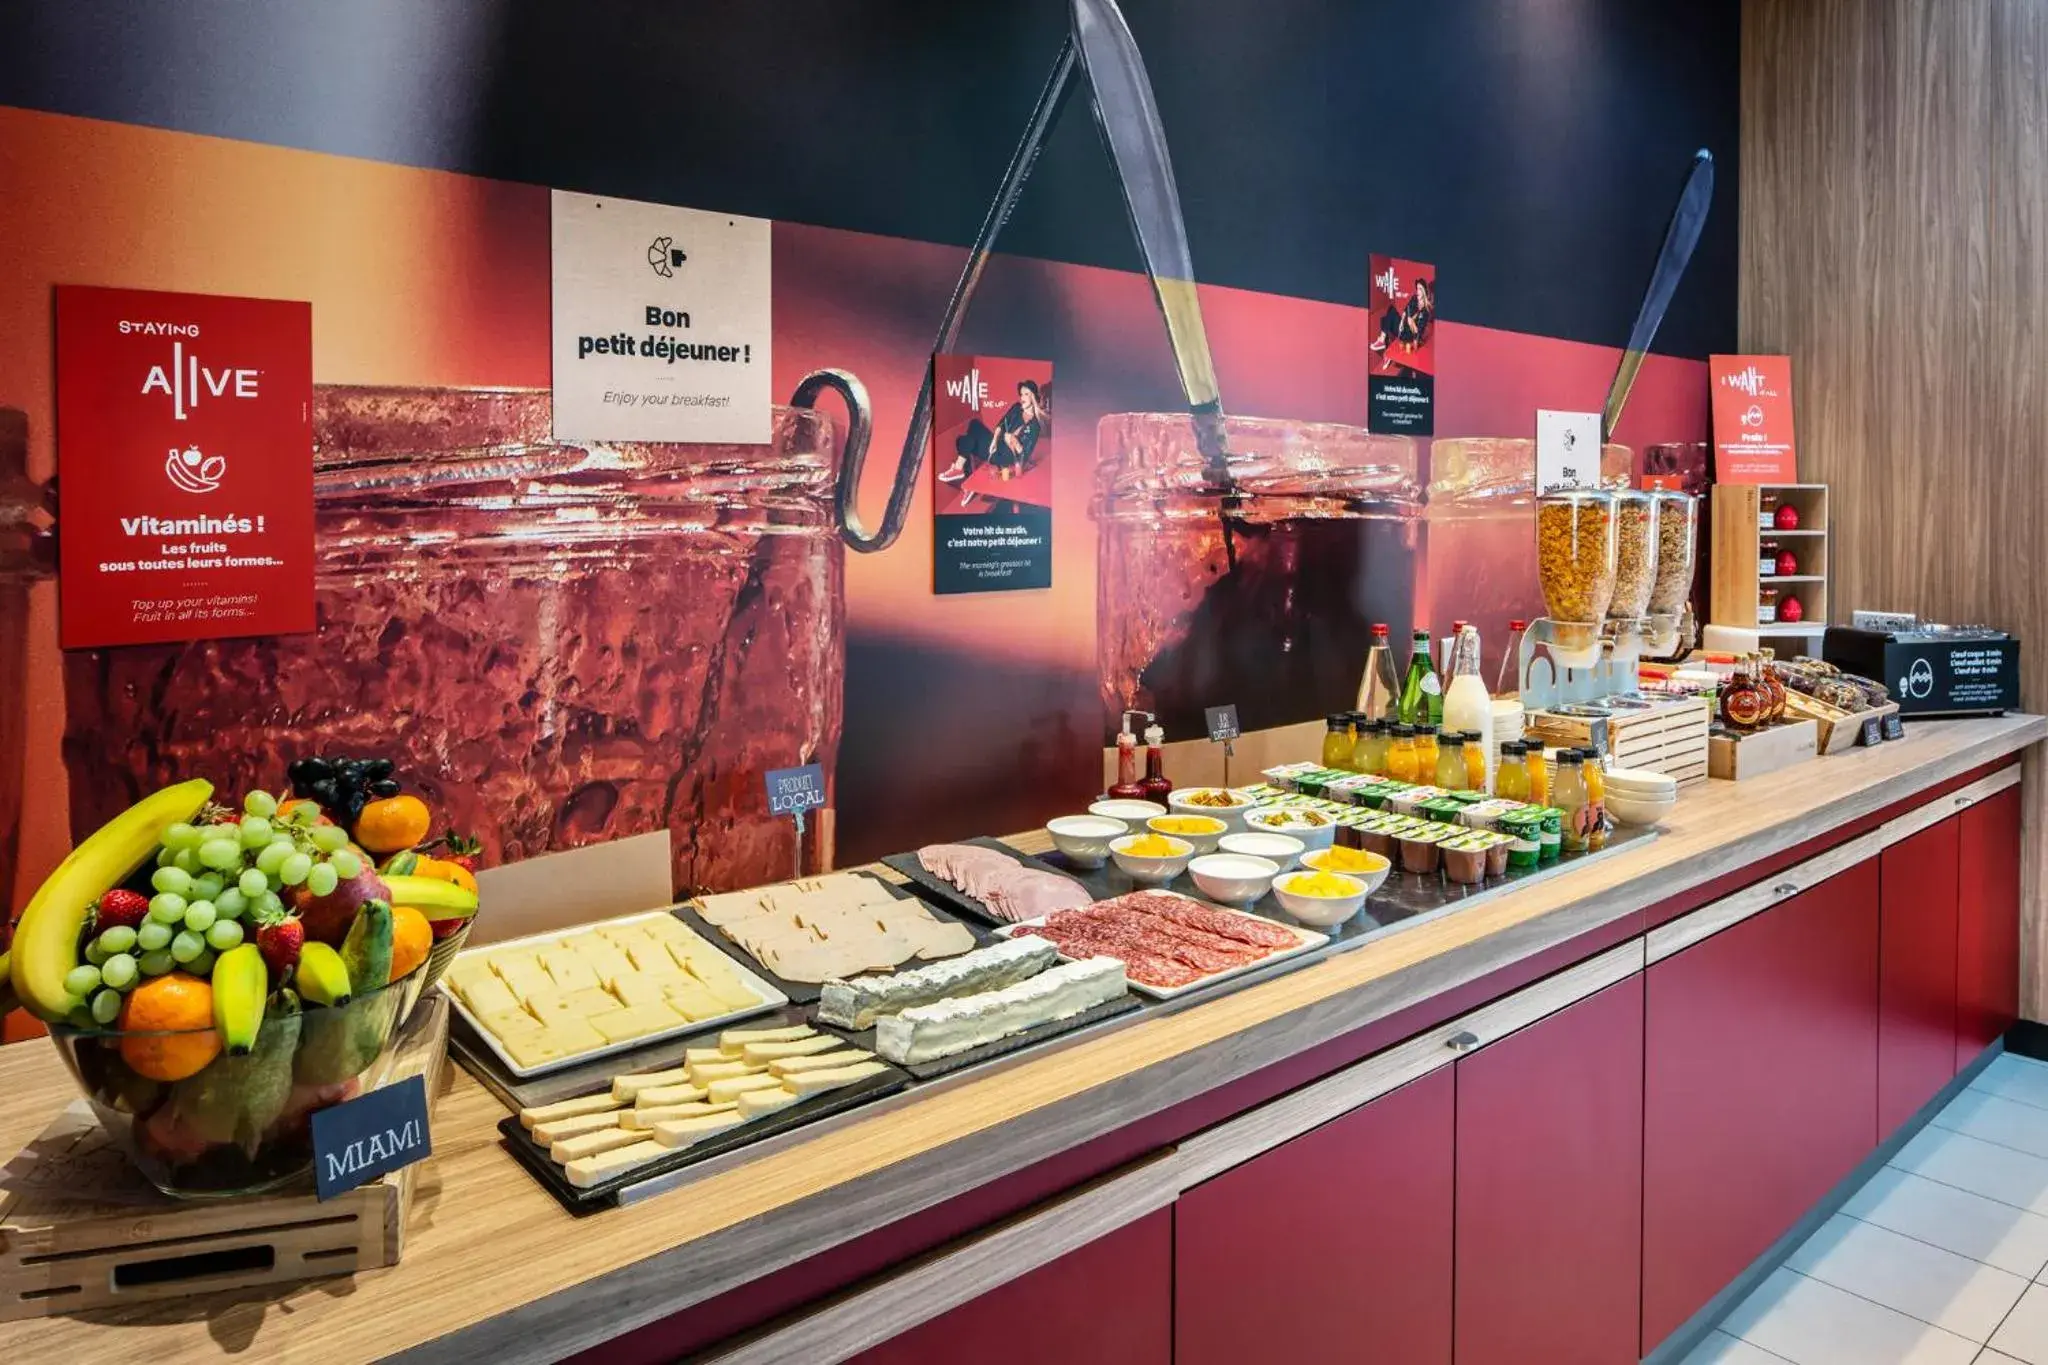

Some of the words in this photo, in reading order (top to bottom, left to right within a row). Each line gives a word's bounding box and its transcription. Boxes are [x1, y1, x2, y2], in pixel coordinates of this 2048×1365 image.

[645, 305, 690, 329] Bon
[119, 320, 199, 337] STAYING
[578, 332, 636, 360] petit
[640, 334, 740, 364] déjeuner
[744, 344, 751, 363] !
[141, 341, 258, 420] ALIVE
[946, 368, 988, 411] WAKE
[602, 391, 639, 407] Enjoy
[641, 395, 670, 407] your
[671, 395, 731, 408] breakfast!
[1563, 467, 1576, 477] Bon
[121, 514, 252, 536] Vitaminés
[257, 515, 264, 533] !
[963, 526, 983, 536] Votre
[162, 543, 187, 555] Les
[189, 542, 227, 554] fruits
[947, 538, 967, 547] c'est
[967, 539, 988, 547] notre
[100, 560, 136, 573] sous
[138, 558, 185, 571] toutes
[187, 557, 222, 569] leurs
[225, 555, 284, 568] formes...
[132, 600, 154, 613] Top
[157, 601, 174, 611] up
[176, 599, 203, 609] your
[206, 595, 258, 606] vitamins!
[133, 612, 162, 623] Fruit
[164, 611, 176, 620] in
[178, 609, 191, 620] all
[194, 608, 208, 619] its
[772, 790, 824, 811] LOCAL
[325, 1119, 421, 1181] MIAM!
